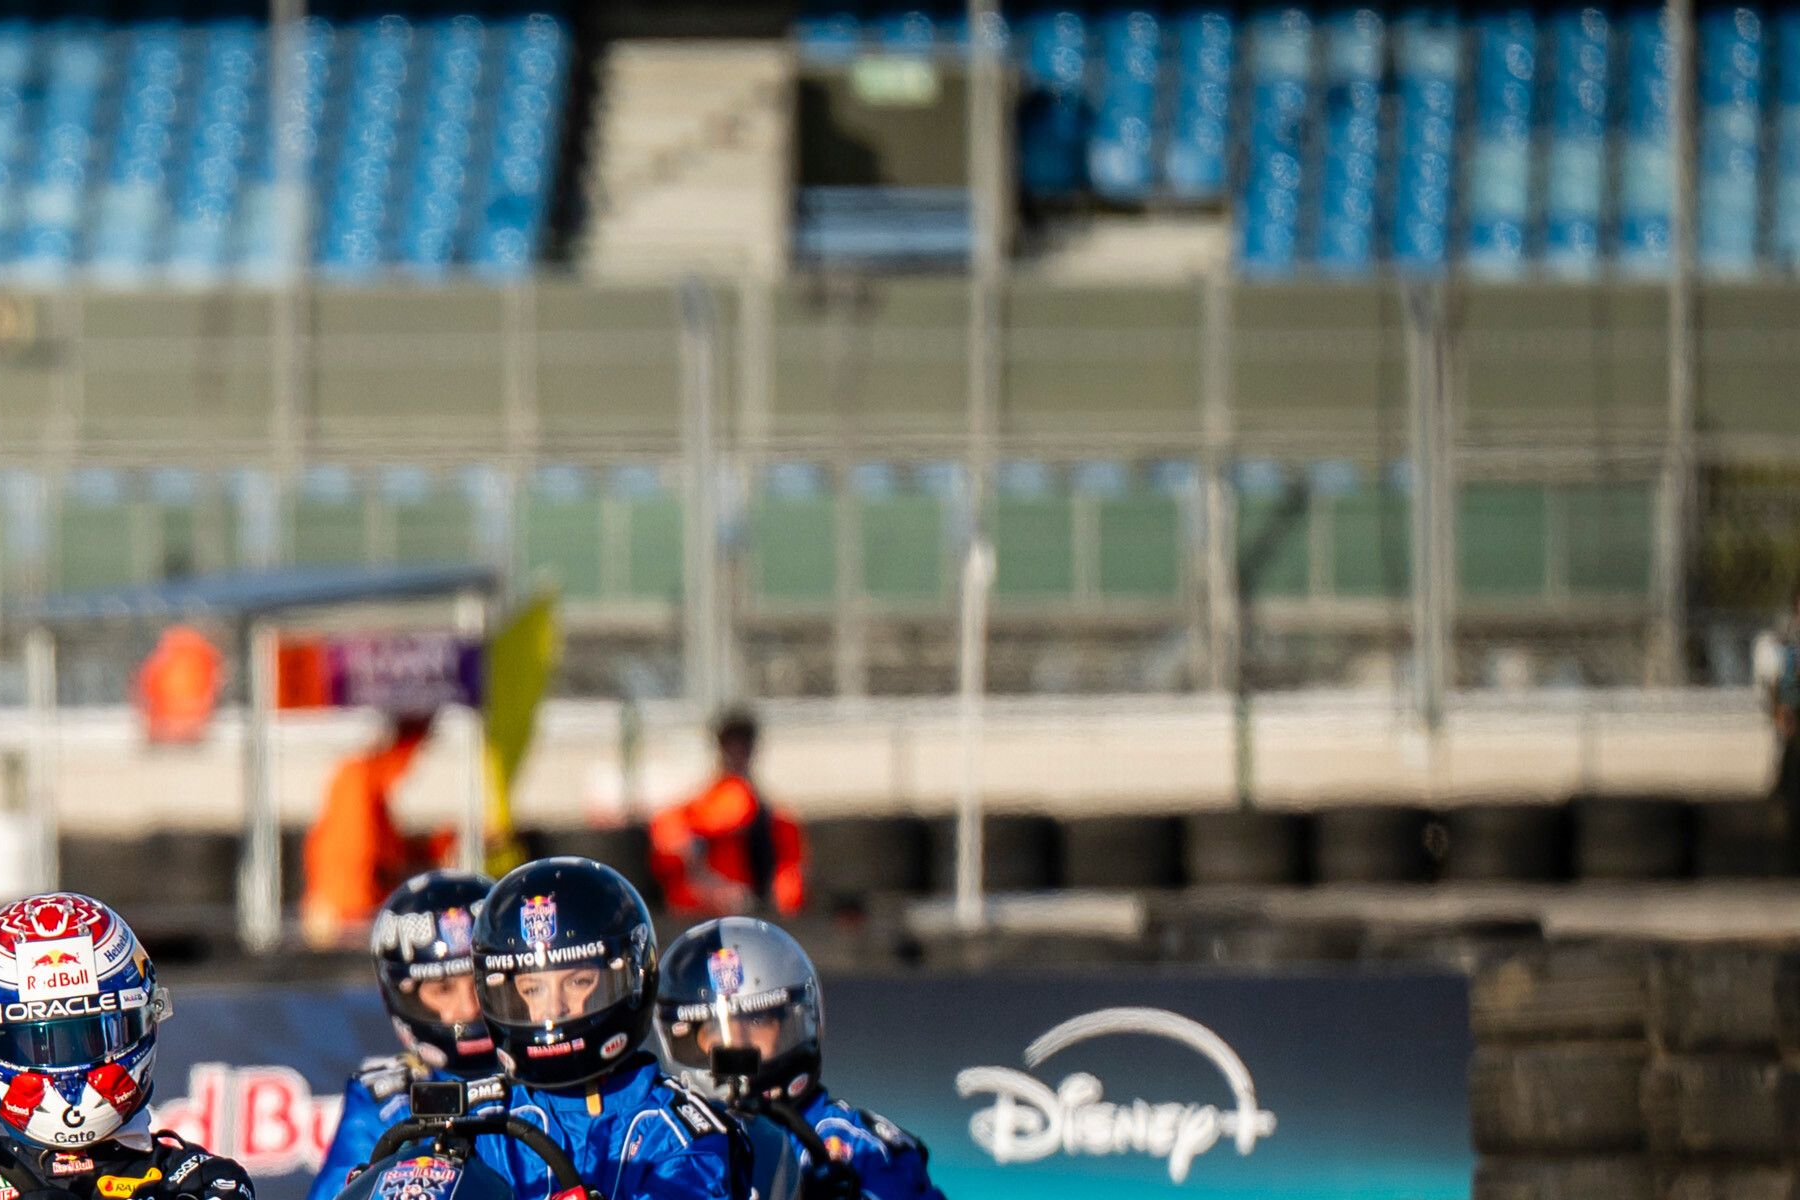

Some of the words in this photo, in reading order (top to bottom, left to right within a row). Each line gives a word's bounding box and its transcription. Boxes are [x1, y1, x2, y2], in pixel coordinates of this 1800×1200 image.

[485, 954, 513, 971] GIVES
[547, 940, 605, 965] WIIINGS
[27, 971, 57, 990] Rd
[60, 969, 89, 988] Bull
[5, 992, 118, 1021] ORACLE
[54, 1130, 96, 1144] Gate
[955, 1066, 1277, 1184] Disney+
[381, 1177, 446, 1193] MAX
